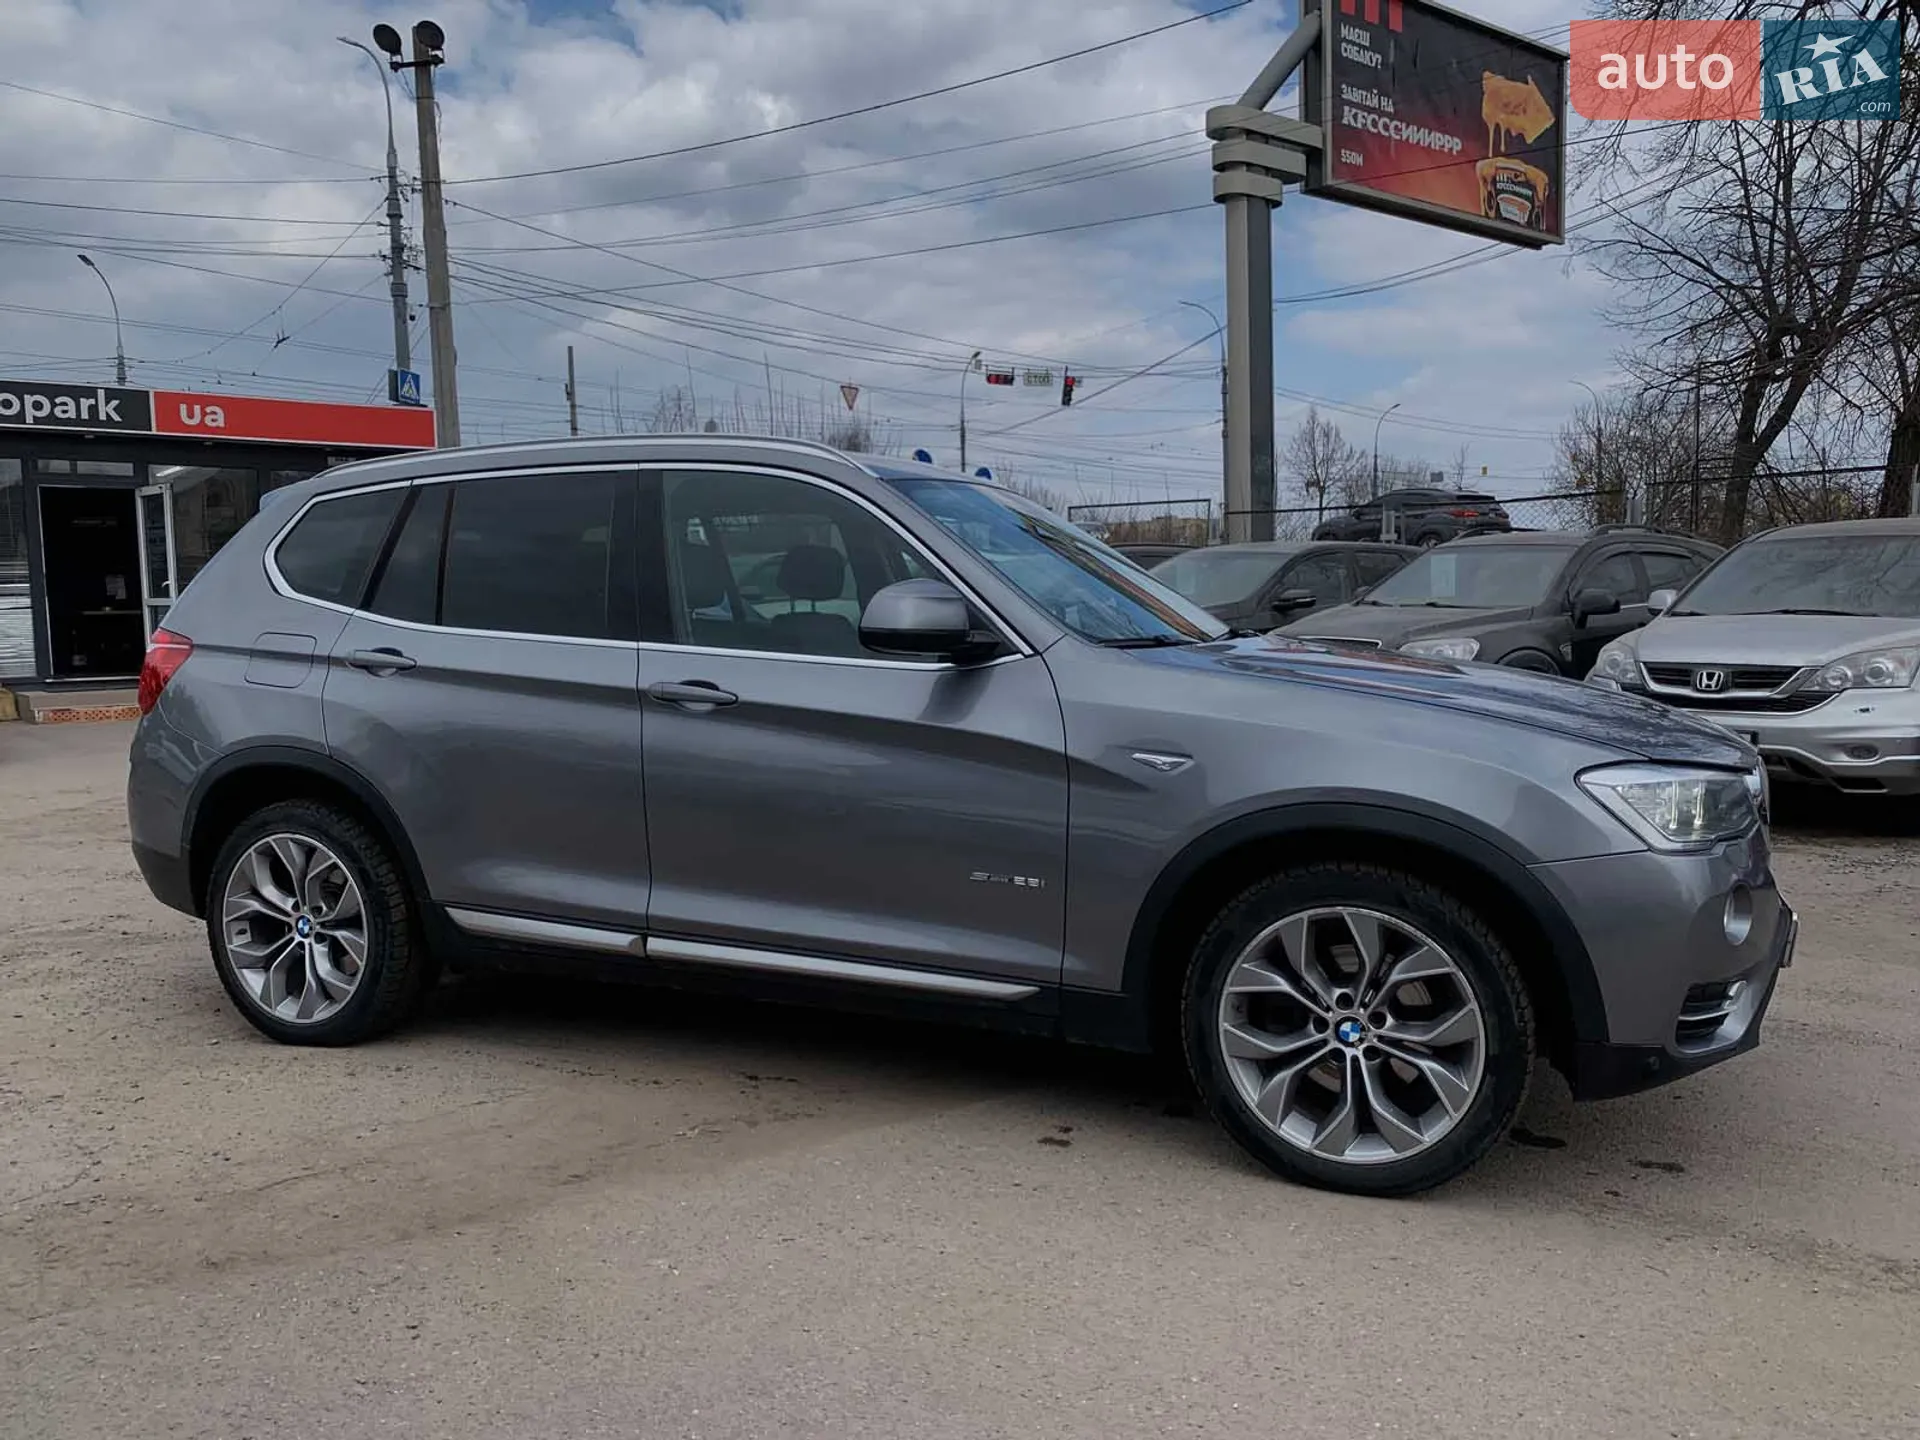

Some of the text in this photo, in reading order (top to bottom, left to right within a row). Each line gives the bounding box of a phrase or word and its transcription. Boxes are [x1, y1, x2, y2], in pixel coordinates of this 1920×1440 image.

[1380, 96, 1394, 113] НА
[0, 388, 225, 428] opark ua
